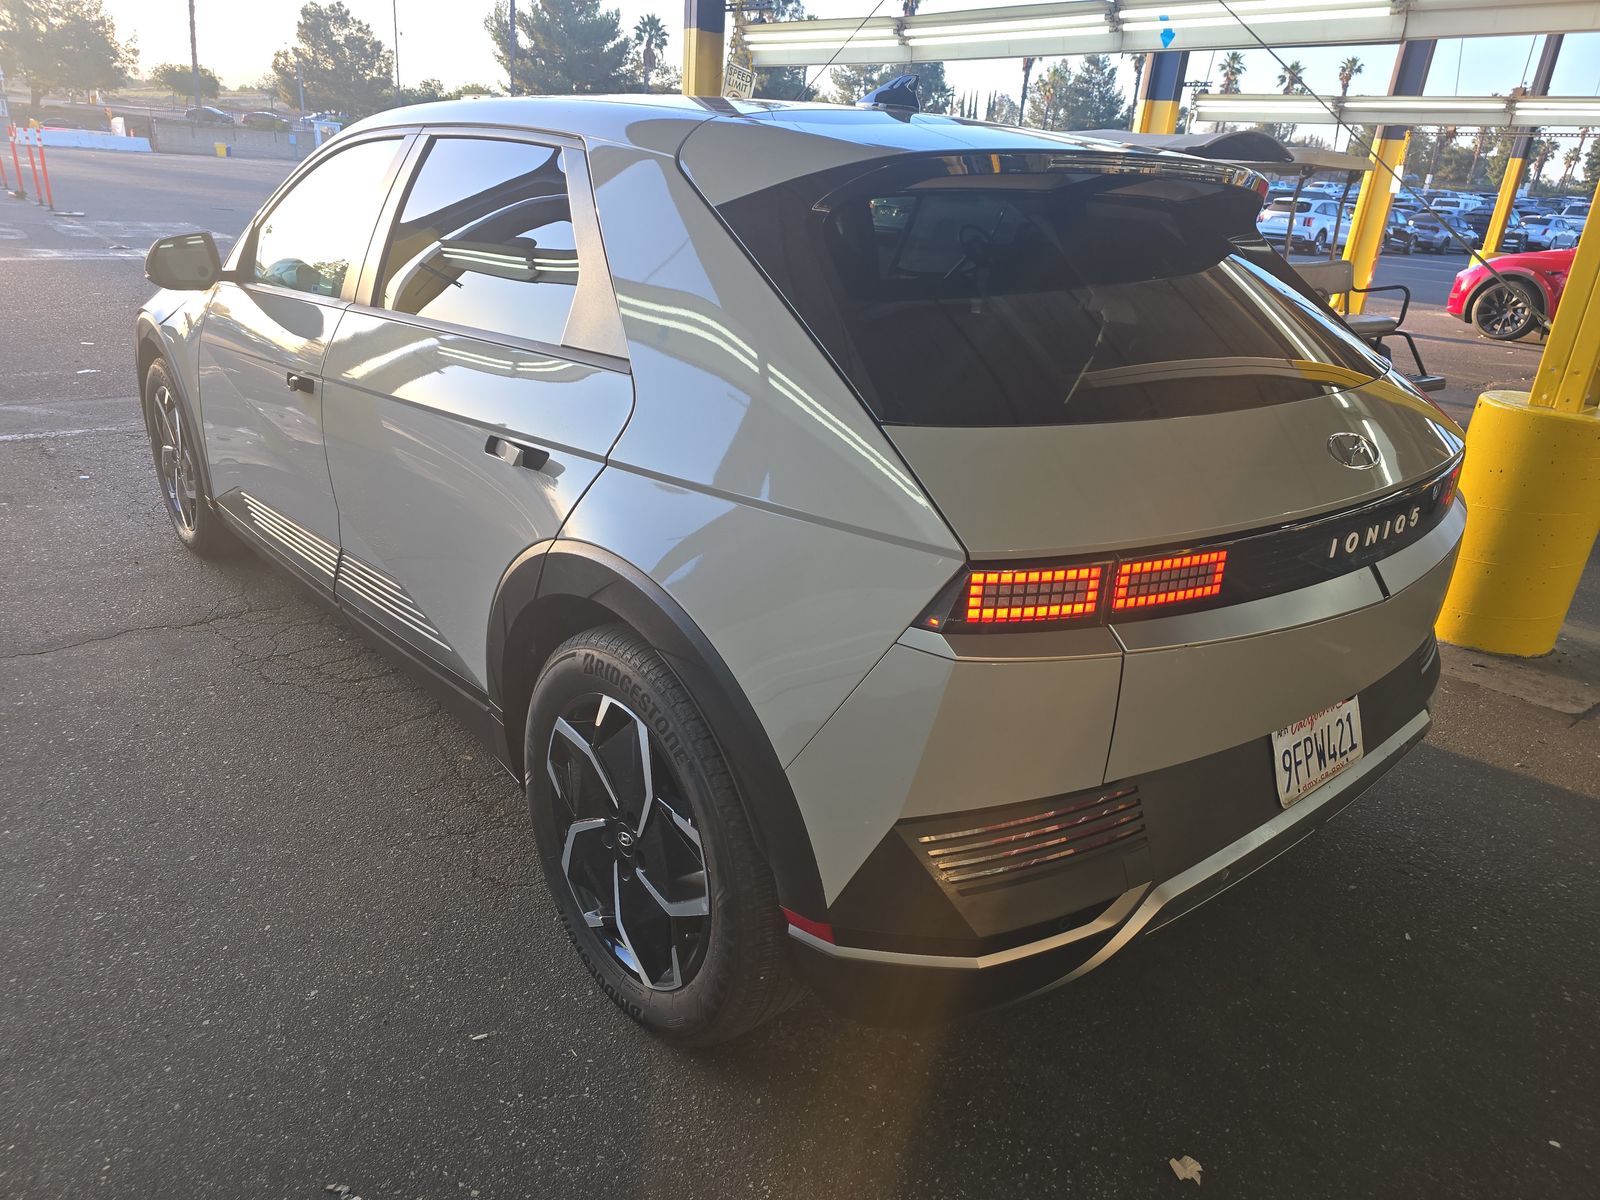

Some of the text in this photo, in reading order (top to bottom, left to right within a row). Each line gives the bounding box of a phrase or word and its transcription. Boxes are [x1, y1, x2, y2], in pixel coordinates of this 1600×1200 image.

[728, 78, 748, 93] LIMIT
[729, 67, 752, 84] SPEED
[582, 653, 685, 767] BRIDGESTONE
[1282, 712, 1358, 793] 9FPW421
[1302, 760, 1345, 793] dmv.ca.gov
